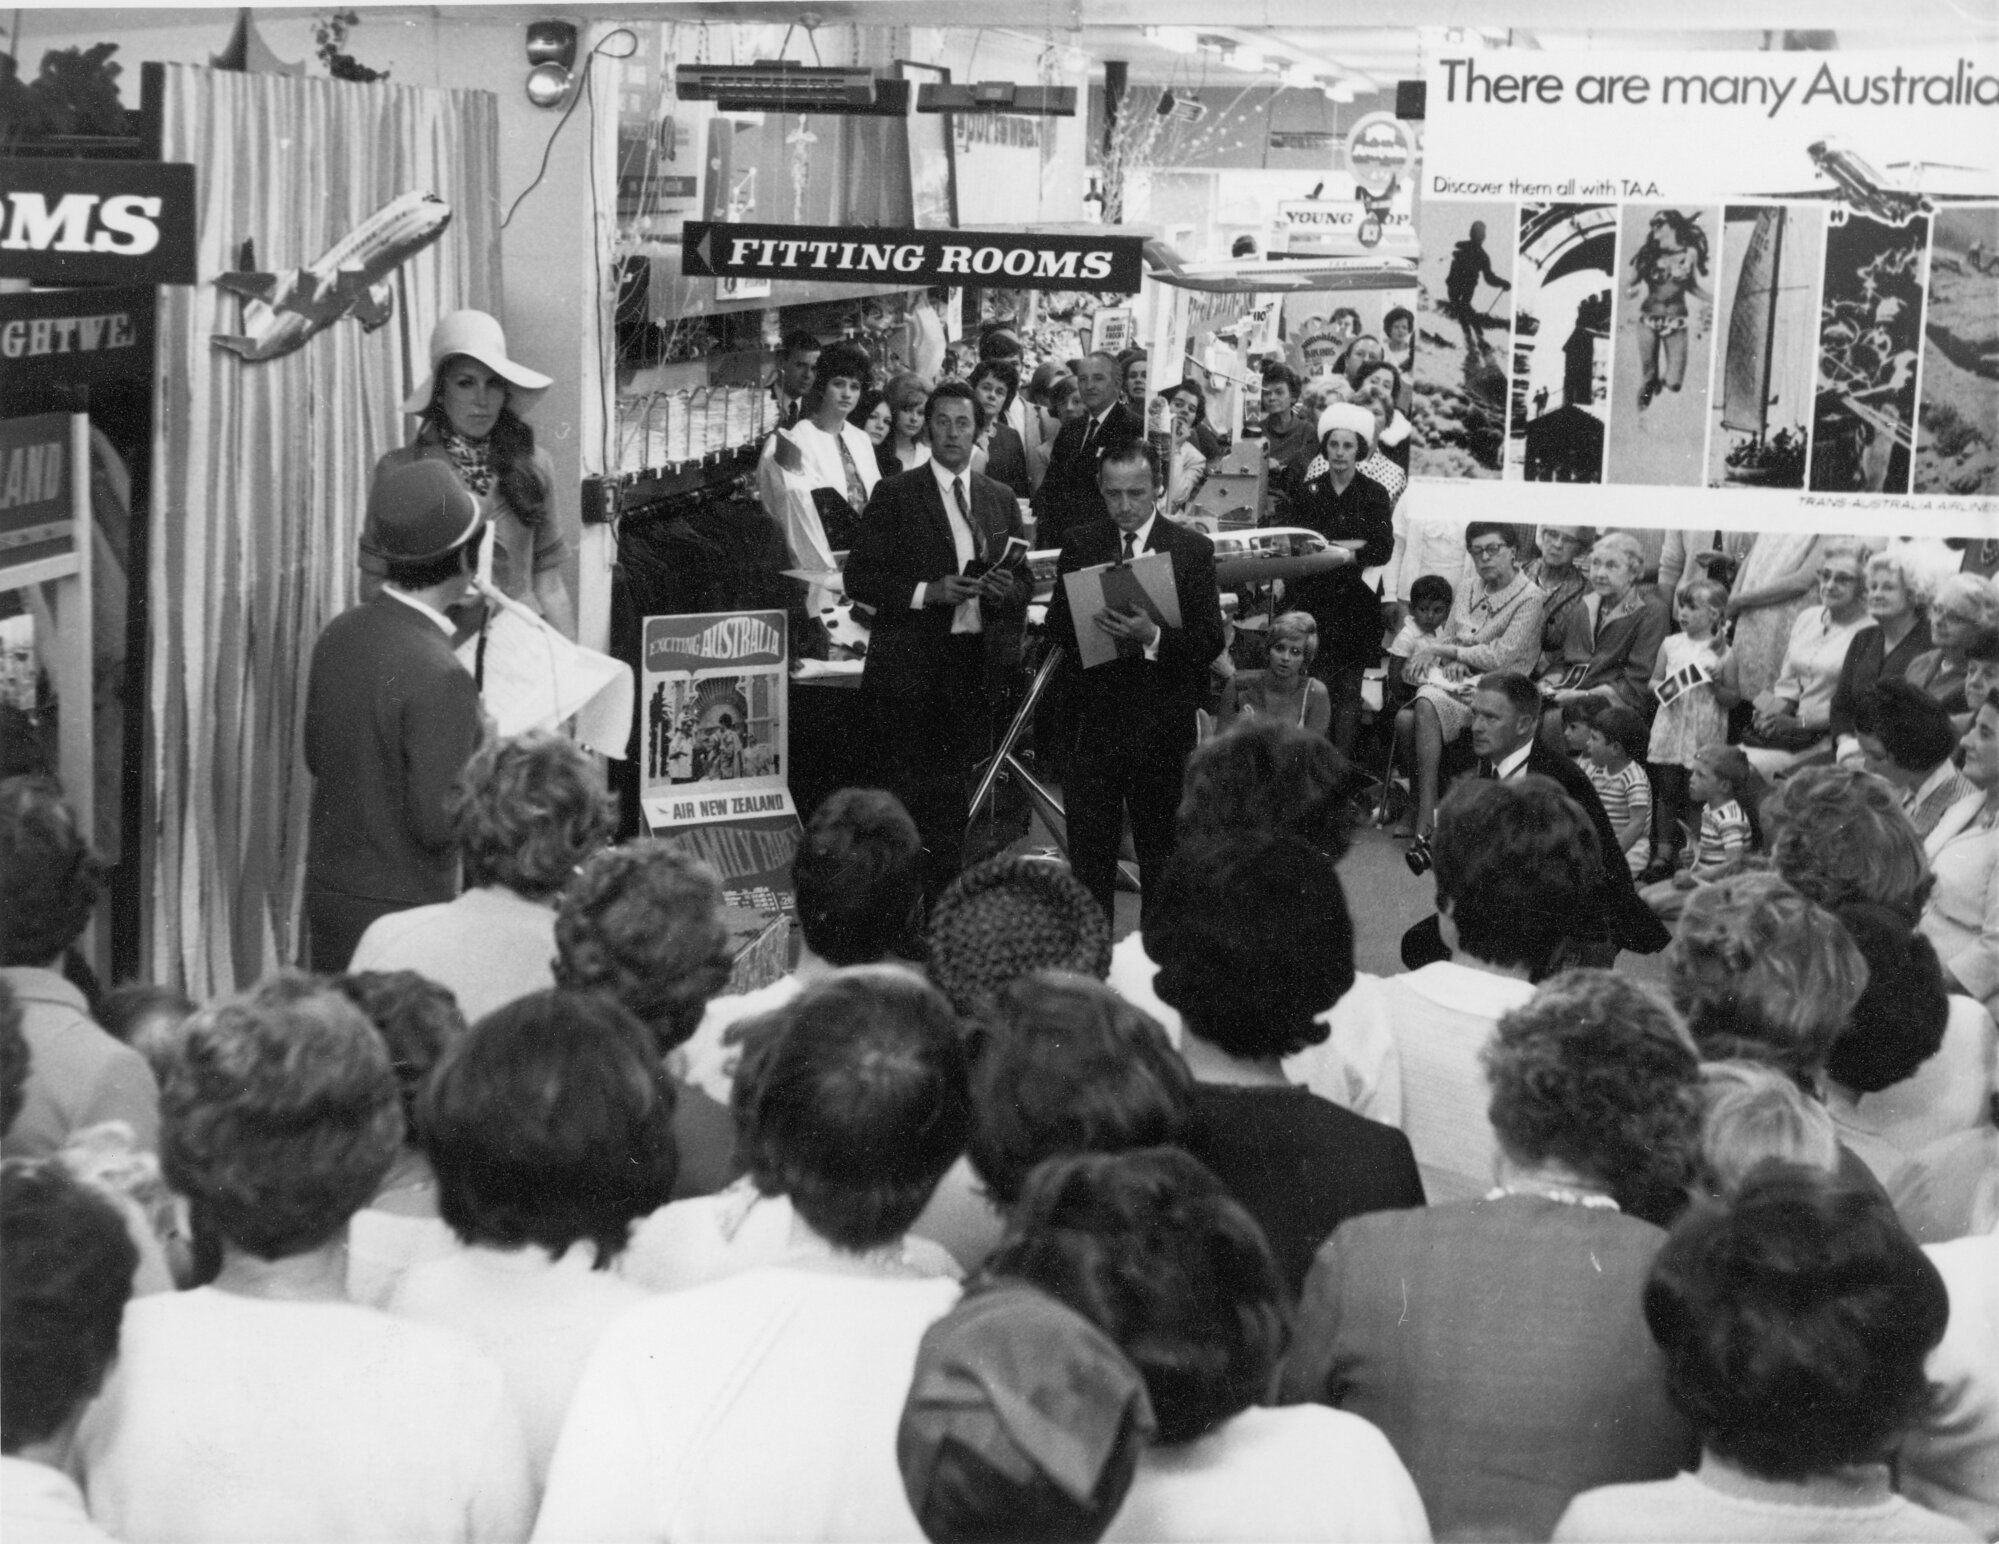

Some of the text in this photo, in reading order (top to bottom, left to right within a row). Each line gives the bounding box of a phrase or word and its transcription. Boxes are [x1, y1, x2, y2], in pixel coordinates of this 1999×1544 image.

[1439, 57, 1564, 104] There
[1575, 73, 1650, 105] are
[1662, 74, 1798, 119] many
[1433, 176, 1504, 197] Discover
[1509, 178, 1553, 196] them
[1556, 178, 1575, 198] all
[1581, 179, 1616, 198] with
[1286, 211, 1354, 225] YOUNG
[727, 238, 1113, 279] FITTING ROOMS
[649, 616, 780, 659] EXCITING AUSTRALIA
[672, 793, 784, 821] AIR NEW ZEALAND
